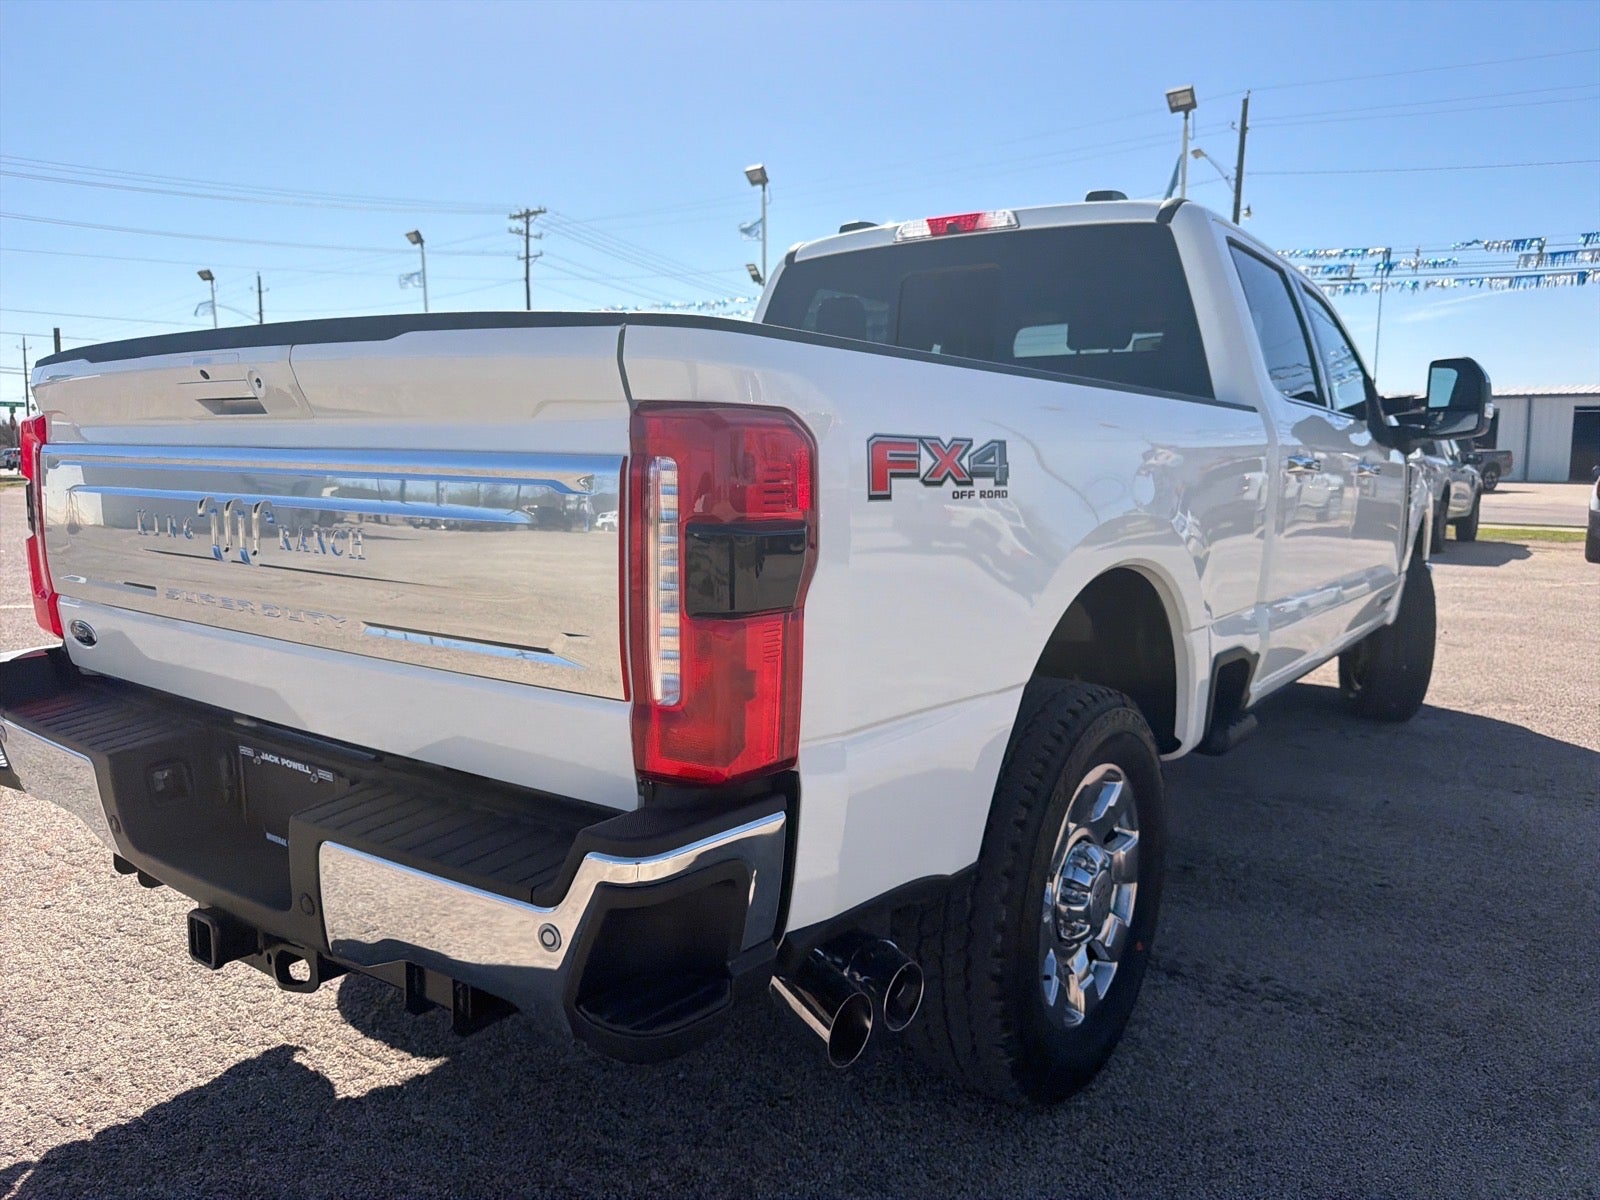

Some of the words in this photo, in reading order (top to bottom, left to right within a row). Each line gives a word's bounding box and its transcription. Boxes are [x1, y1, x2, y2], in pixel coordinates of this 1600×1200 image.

[867, 433, 1009, 501] FX4
[952, 489, 975, 499] OFF
[979, 489, 1008, 499] ROAD
[260, 752, 280, 764] JACK
[280, 757, 312, 774] POWELL
